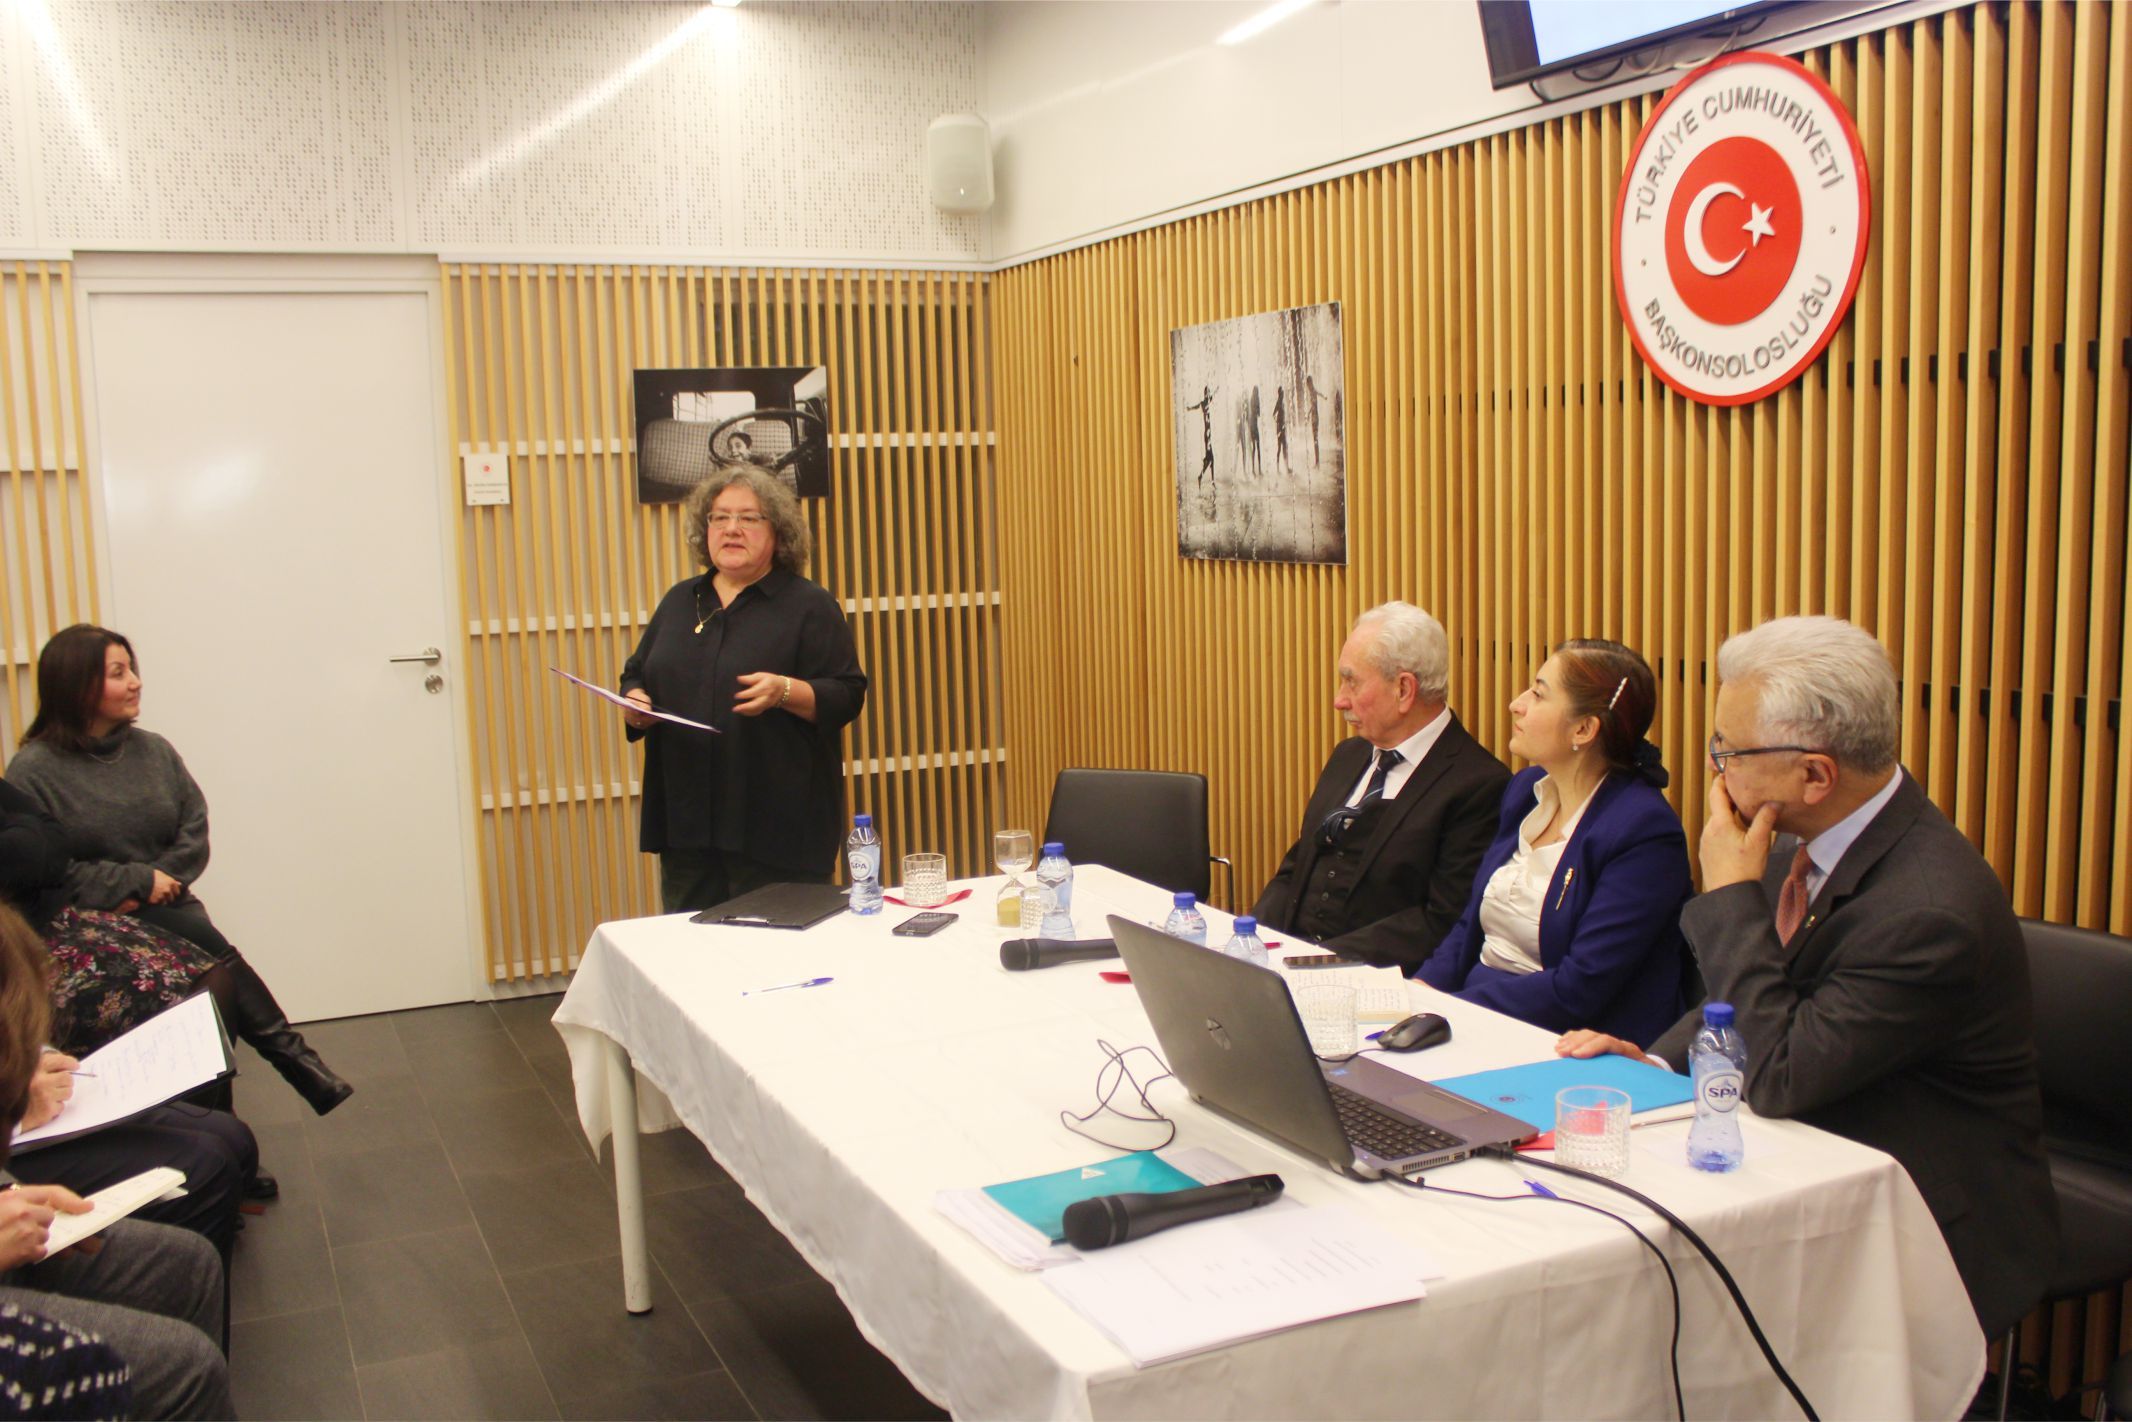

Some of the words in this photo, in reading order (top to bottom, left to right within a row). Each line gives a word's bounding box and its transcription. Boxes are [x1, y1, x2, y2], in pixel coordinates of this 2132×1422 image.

[1635, 108, 1700, 224] TÜRKİYE
[1702, 85, 1845, 190] CUMHURİYETİ
[1644, 273, 1833, 379] BAŞKONSOLOSLUĞU
[850, 861, 867, 870] SPA
[1708, 1087, 1738, 1099] SPA
